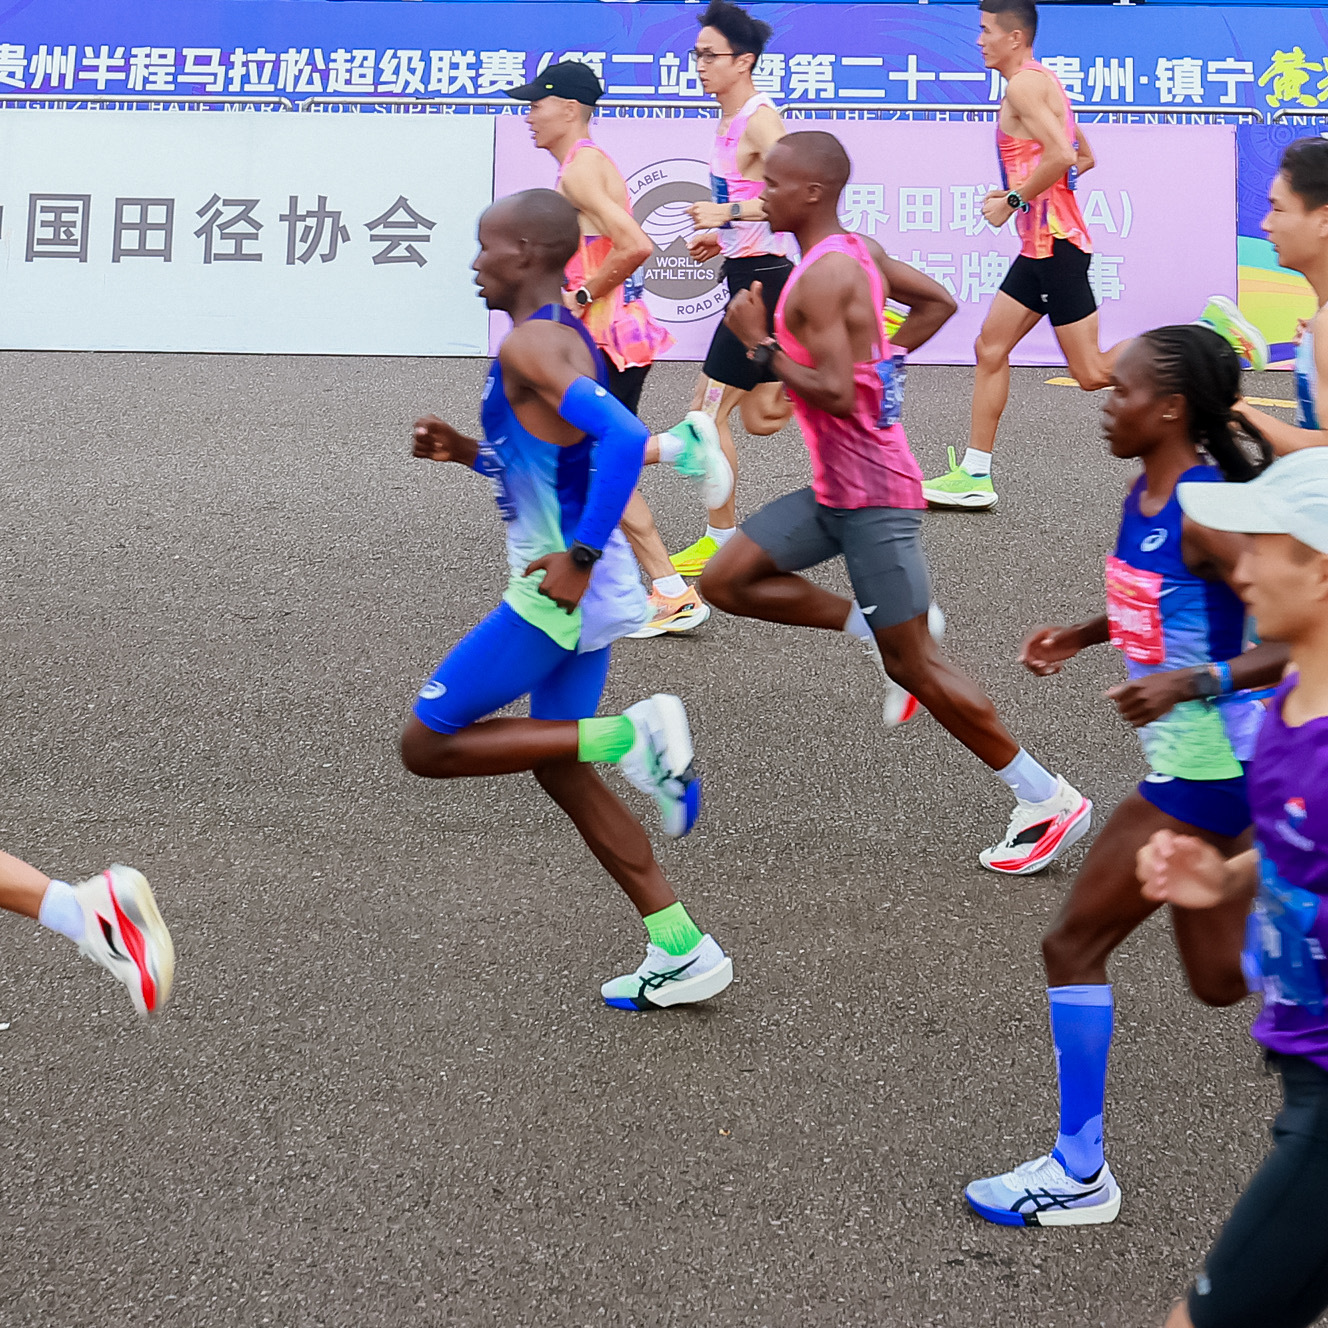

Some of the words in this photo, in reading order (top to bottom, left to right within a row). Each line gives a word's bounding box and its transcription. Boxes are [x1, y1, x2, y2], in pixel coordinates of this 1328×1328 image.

[631, 170, 668, 196] LABEL
[656, 258, 703, 269] WORLD
[644, 269, 715, 281] ATHLETICS
[676, 301, 708, 316] ROAD
